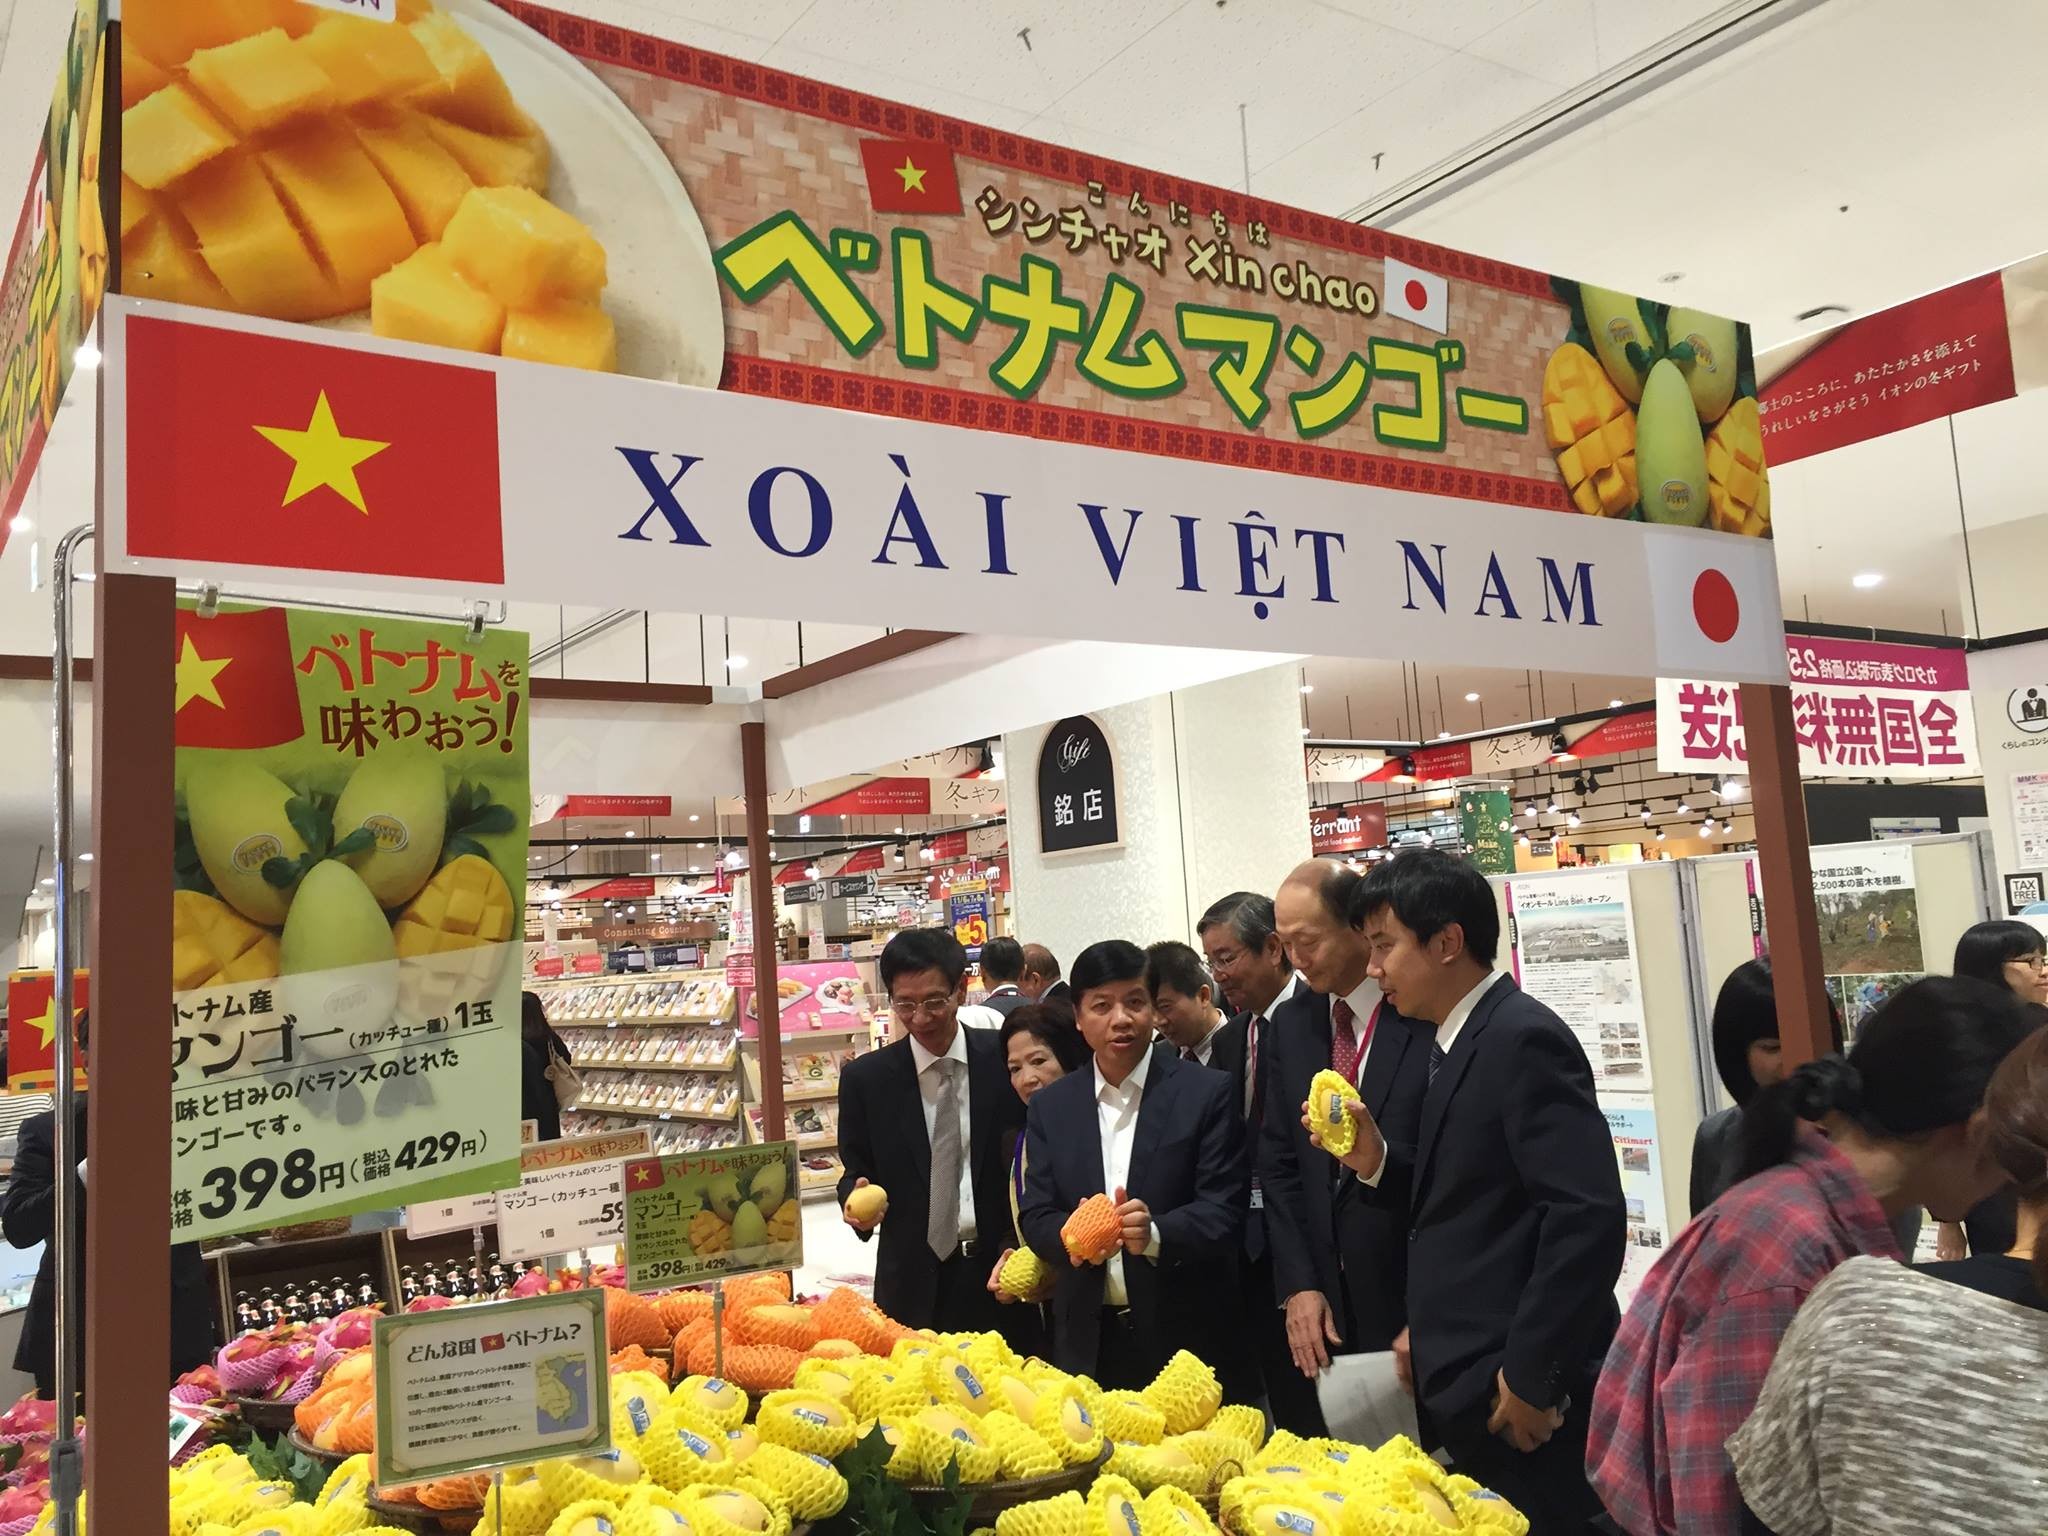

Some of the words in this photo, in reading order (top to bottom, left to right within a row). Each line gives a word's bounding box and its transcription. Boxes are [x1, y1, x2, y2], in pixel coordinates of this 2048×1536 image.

[1087, 181, 1270, 246] こんにちは
[976, 185, 1168, 273] シンチャオ
[1186, 239, 1262, 290] Xin
[1273, 261, 1377, 315] chao
[714, 210, 1528, 451] ベトナムマンゴー
[1878, 360, 1981, 401] イオンの冬ギフト
[615, 446, 1018, 576] XOÀI
[1077, 503, 1345, 620] VIỆT
[1397, 540, 1603, 627] NAM
[296, 628, 521, 704] ベトナムを
[1057, 734, 1091, 773] Gift
[1054, 789, 1102, 826] 銘店
[2012, 879, 2036, 891] TAX
[2013, 888, 2038, 900] FREE
[603, 926, 656, 938] Consulting
[658, 924, 690, 936] Counter
[455, 1000, 494, 1029] 1玉
[171, 1047, 459, 1124] 味と甘みのバランスのとれた
[171, 1114, 302, 1158] ンゴーです。
[1614, 1135, 1653, 1145] Citimart
[634, 1200, 696, 1220] マンゴー
[407, 1338, 477, 1364] どんな国
[506, 1323, 582, 1348] ベトナム?
